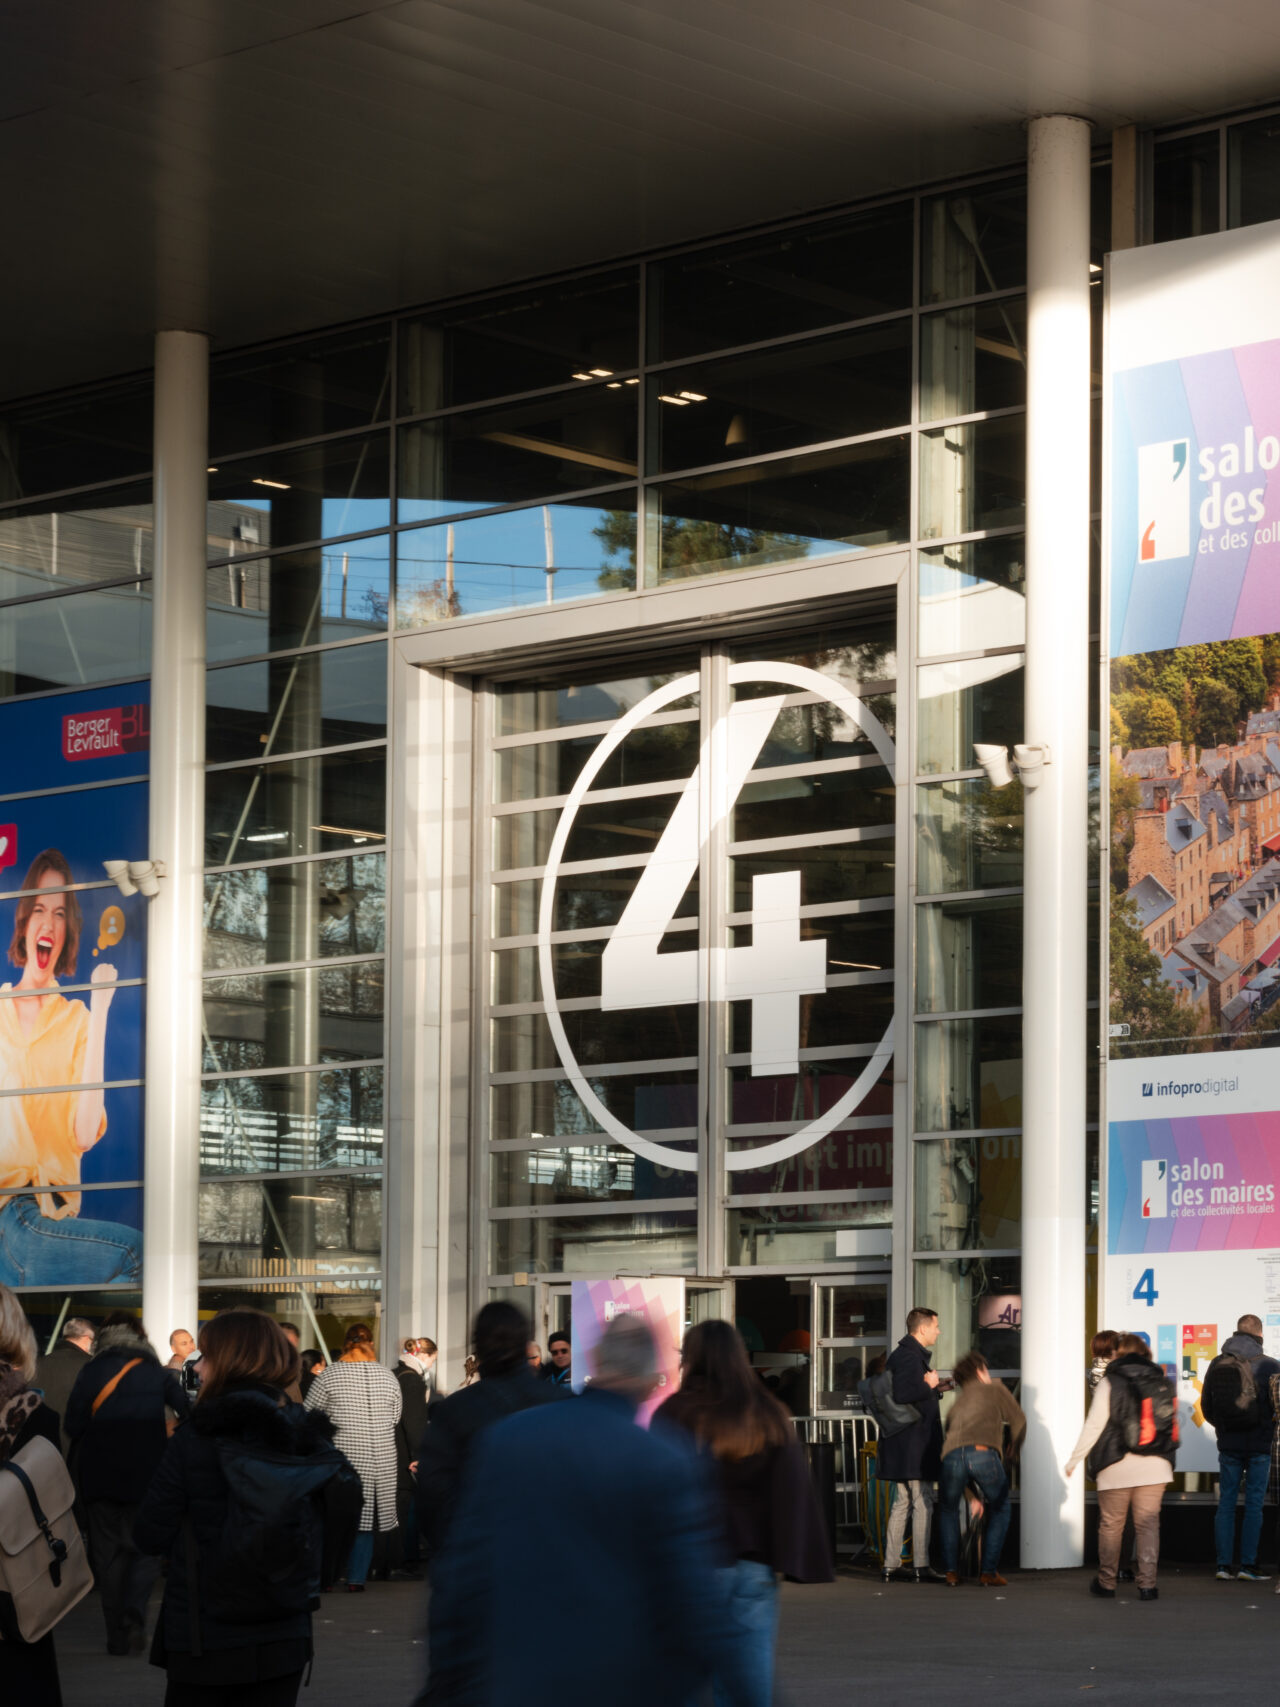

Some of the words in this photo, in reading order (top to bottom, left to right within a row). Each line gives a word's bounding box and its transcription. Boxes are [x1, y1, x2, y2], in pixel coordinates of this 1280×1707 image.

[1199, 481, 1265, 530] des
[1198, 533, 1214, 554] et
[1220, 528, 1248, 550] des
[67, 717, 111, 738] Berger
[67, 728, 119, 754] Levrault
[601, 694, 827, 1077] 4
[1156, 1076, 1239, 1098] infoprodigital
[1171, 1157, 1224, 1182] salon
[1171, 1182, 1204, 1206] des
[1210, 1179, 1275, 1204] maires
[1170, 1207, 1179, 1218] et
[1182, 1206, 1195, 1217] des
[1197, 1204, 1245, 1217] collectivités
[1247, 1202, 1275, 1214] locales
[1133, 1268, 1159, 1307] 4
[998, 1303, 1021, 1324] Ar
